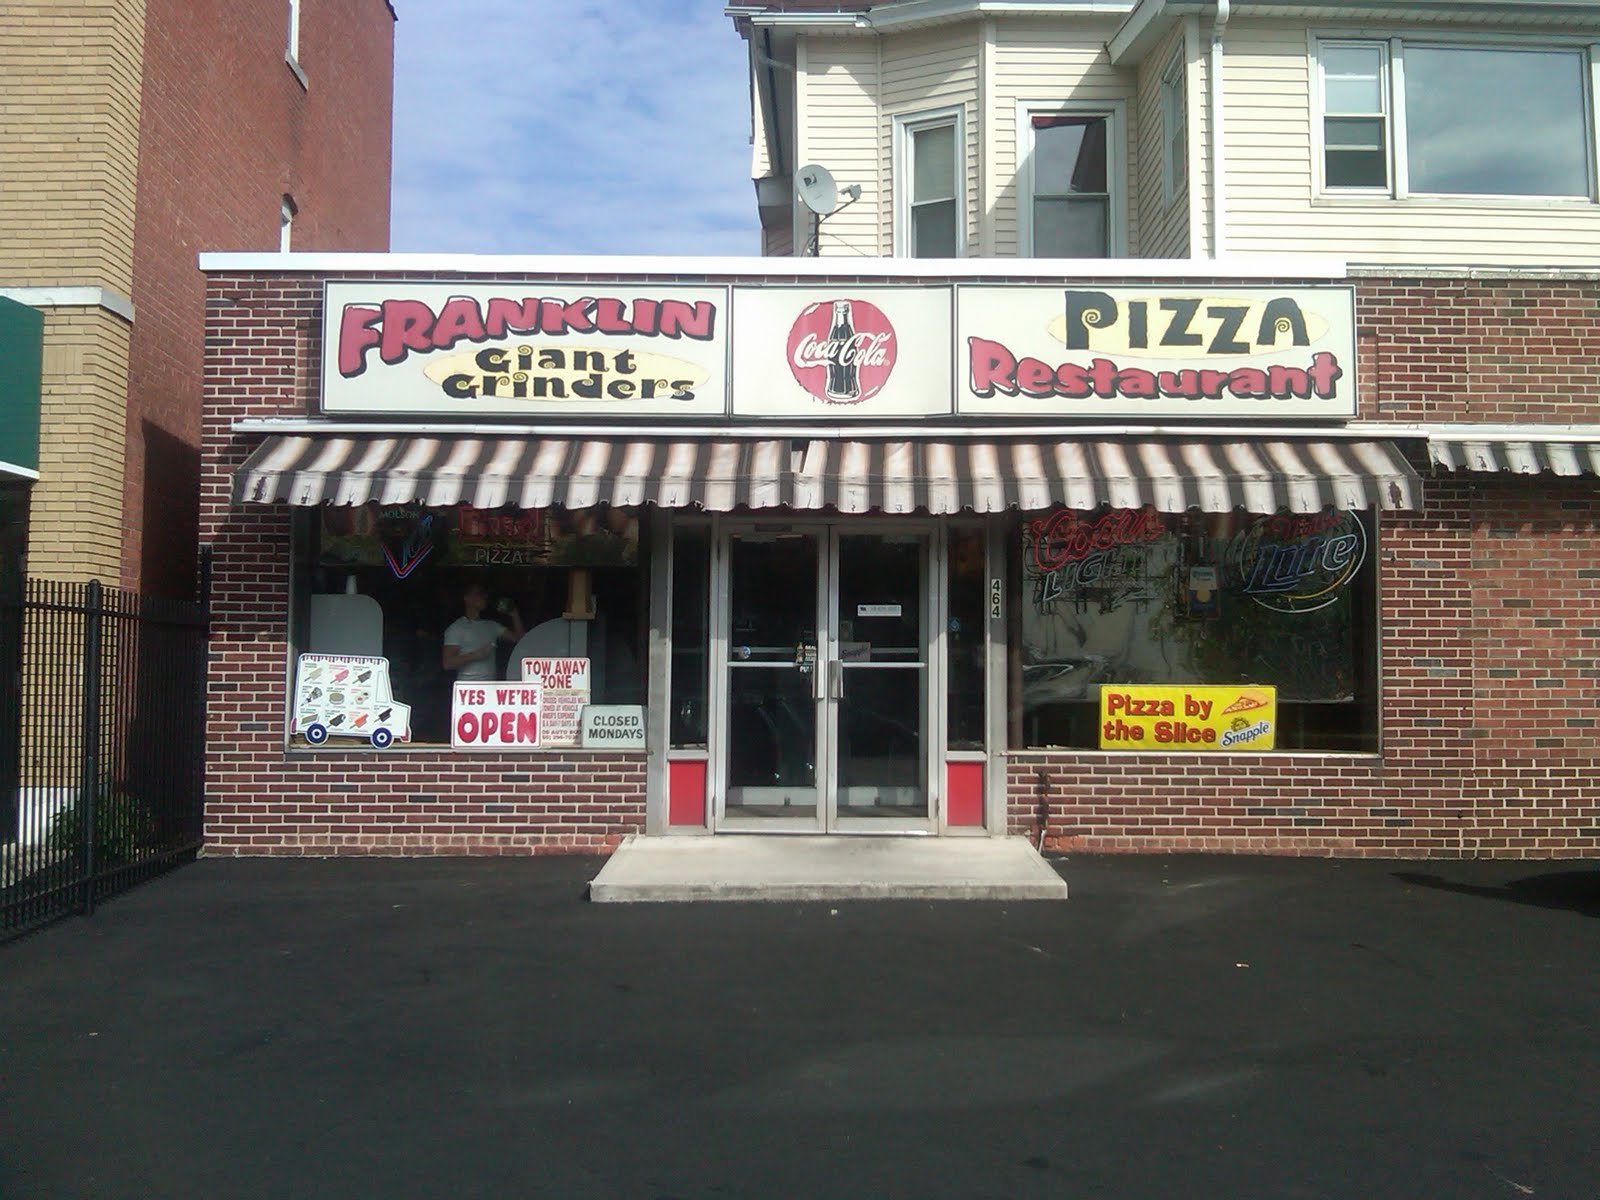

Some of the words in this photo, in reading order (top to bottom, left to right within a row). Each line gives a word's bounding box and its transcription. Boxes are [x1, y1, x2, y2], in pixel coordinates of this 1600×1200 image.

[1065, 290, 1311, 354] PIZZA
[338, 295, 716, 379] FRANKLIN
[794, 332, 892, 369] Coca-Cola
[475, 344, 637, 374] Giant
[967, 336, 1343, 400] Restaurant
[442, 371, 696, 401] Grinders
[475, 549, 523, 564] PIZZA
[992, 580, 1001, 618] 464
[525, 661, 552, 675] TOW
[555, 661, 587, 675] AWAY
[541, 675, 572, 689] ZONE
[459, 689, 486, 706] YES
[496, 689, 537, 706] WE'RE
[1107, 693, 1175, 717] Pizza
[1184, 694, 1213, 721] by
[457, 711, 537, 744] OPEN
[588, 728, 643, 739] MONDAYS
[593, 715, 639, 726] CLOSED
[1103, 719, 1144, 741] the
[1154, 721, 1217, 743] Slice
[1222, 721, 1269, 747] Snapple
